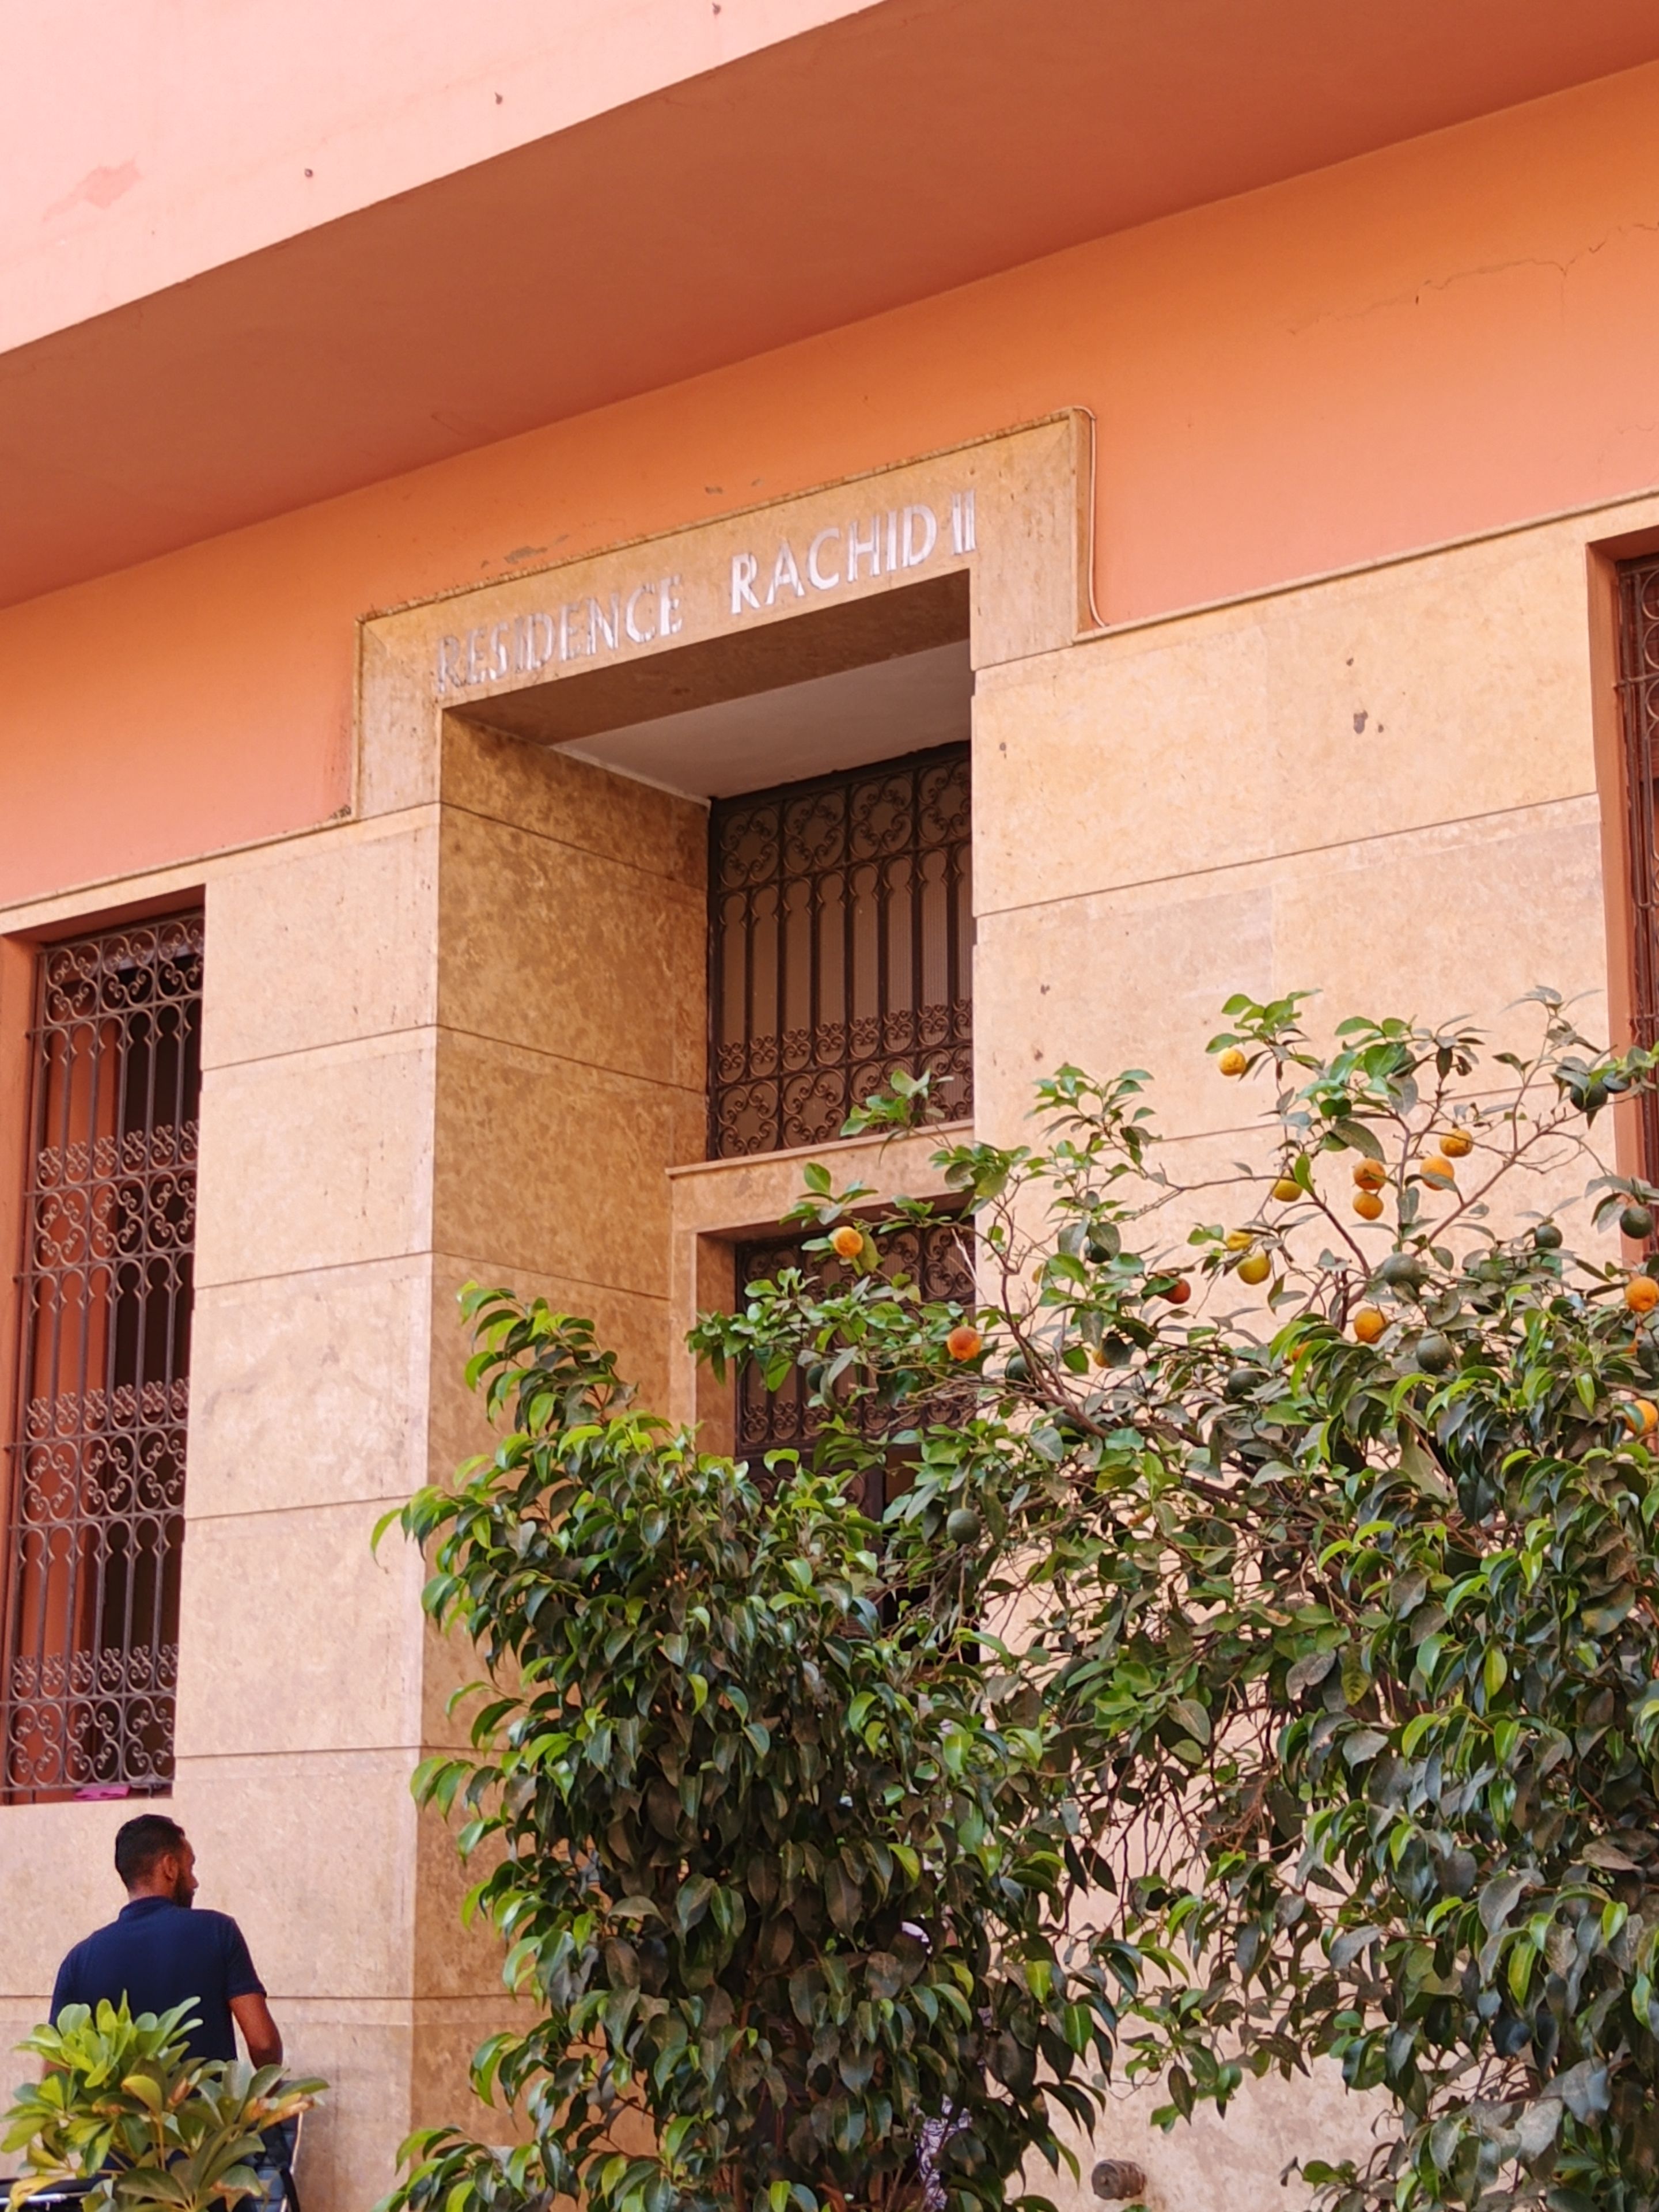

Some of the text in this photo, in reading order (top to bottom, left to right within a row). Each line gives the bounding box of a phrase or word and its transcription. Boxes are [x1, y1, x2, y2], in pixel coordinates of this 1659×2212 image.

[437, 490, 976, 693] RESIDENCE RACHID II
